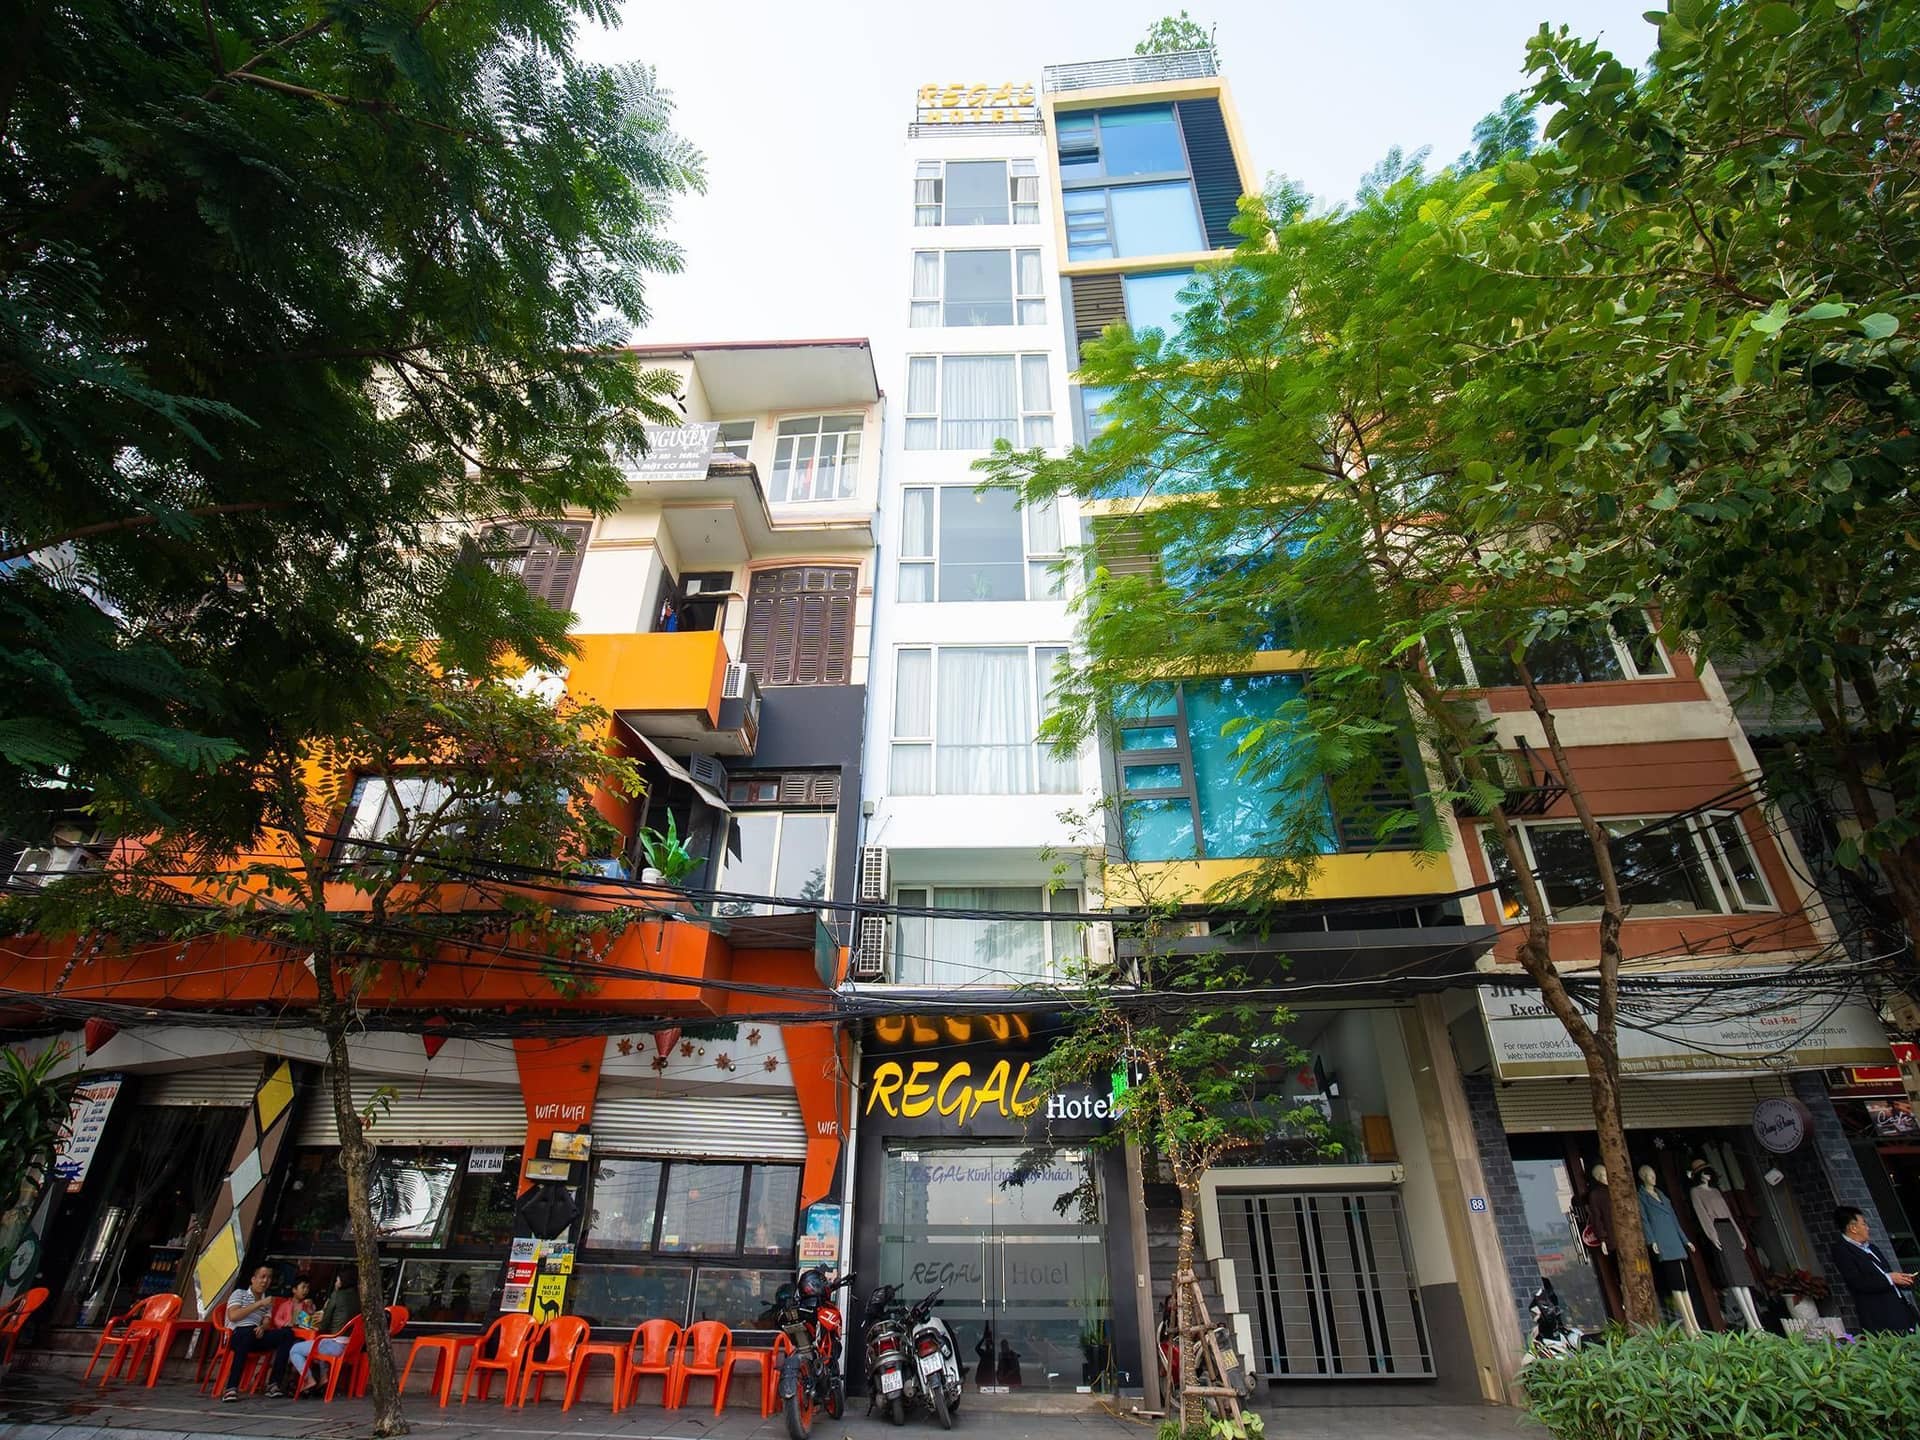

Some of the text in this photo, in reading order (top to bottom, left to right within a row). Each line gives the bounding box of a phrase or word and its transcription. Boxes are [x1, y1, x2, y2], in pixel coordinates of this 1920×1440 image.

[918, 83, 1036, 109] REGAL
[866, 1059, 1117, 1128] REGAL Hotel
[535, 1103, 586, 1120] WIFI WIFI
[817, 1120, 838, 1135] WIFI
[1472, 1199, 1484, 1210] 88
[910, 1260, 1069, 1286] REGAL Hotel
